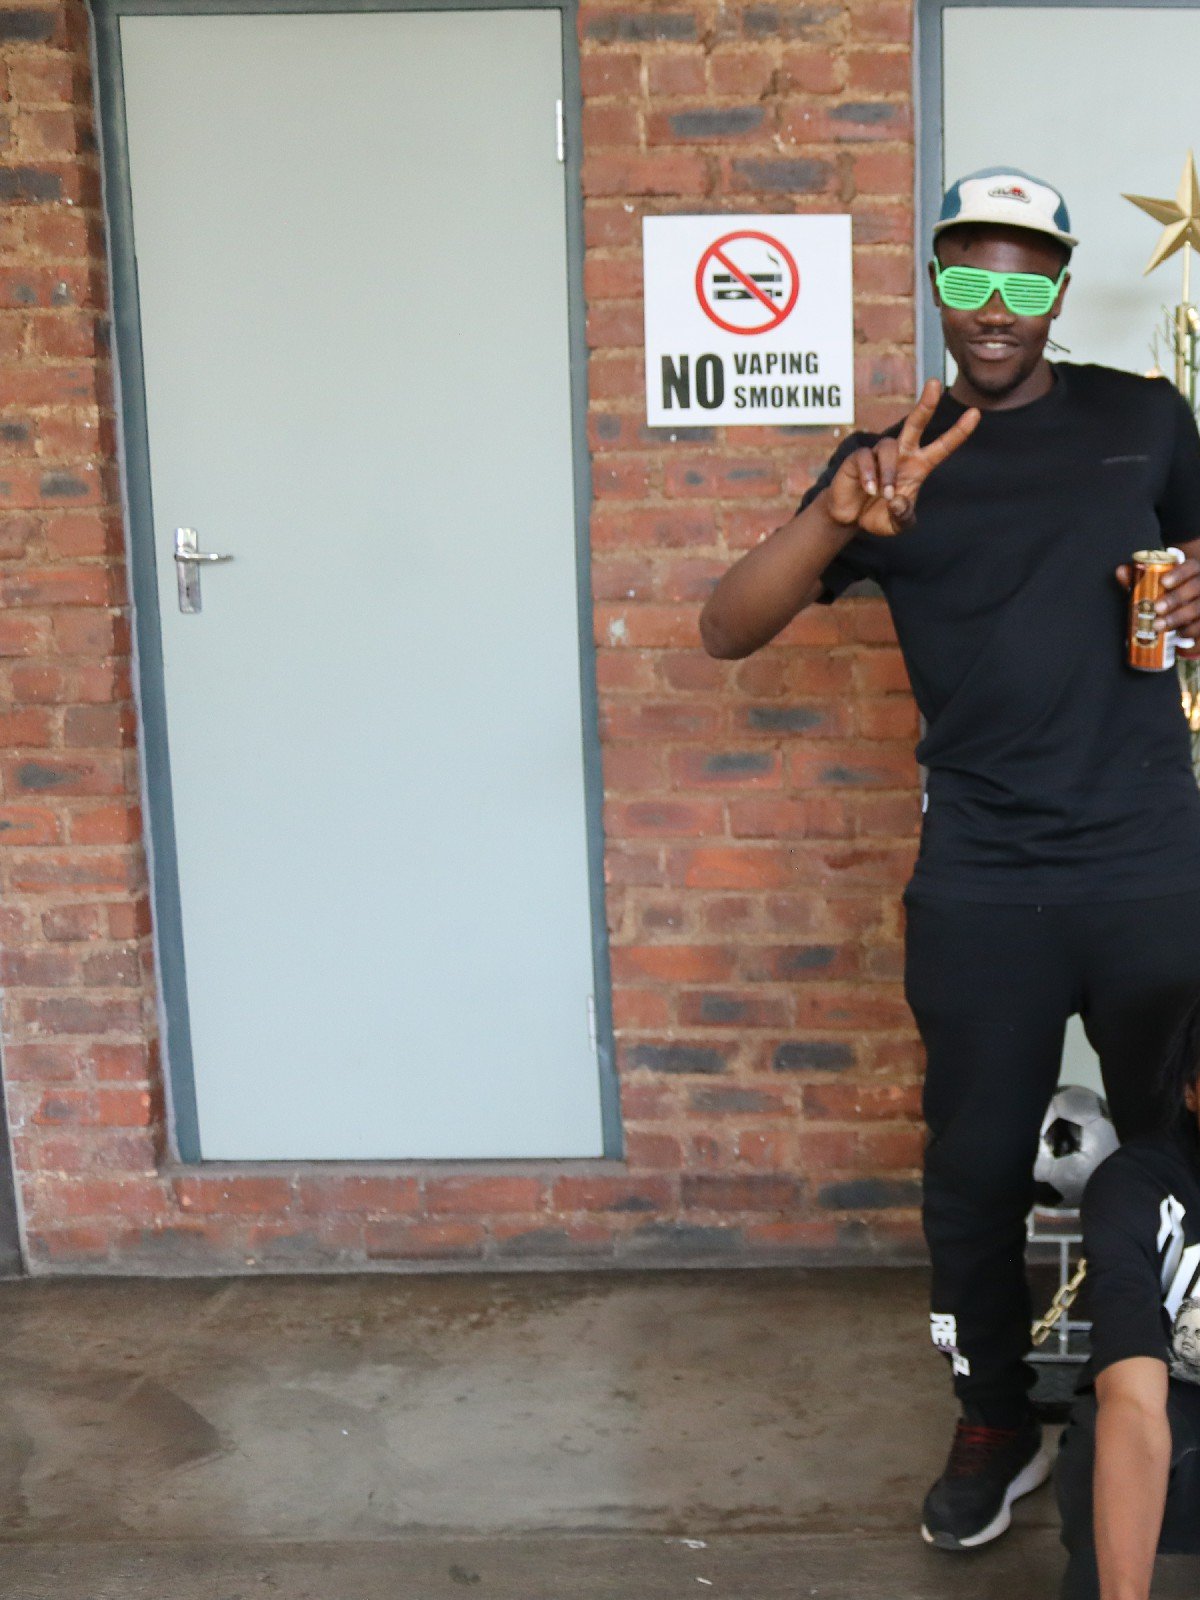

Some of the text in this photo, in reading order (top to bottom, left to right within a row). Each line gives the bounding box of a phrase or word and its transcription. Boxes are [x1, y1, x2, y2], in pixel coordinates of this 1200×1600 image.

[661, 352, 819, 410] NO VAPING
[733, 385, 841, 409] SMOKING
